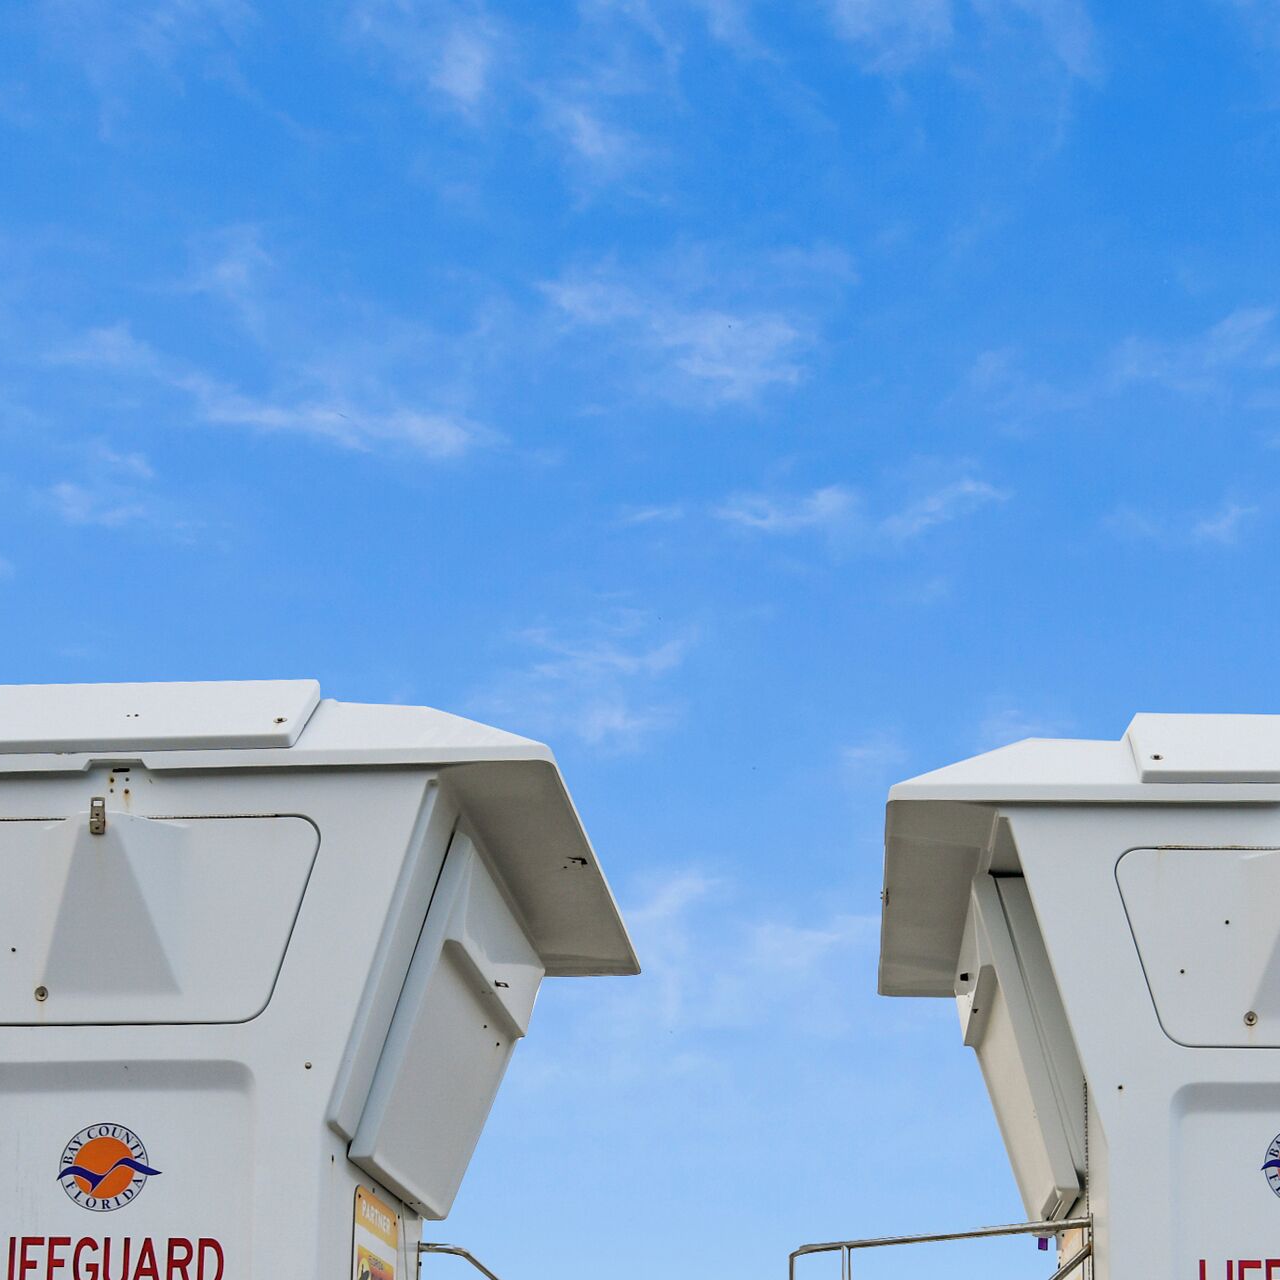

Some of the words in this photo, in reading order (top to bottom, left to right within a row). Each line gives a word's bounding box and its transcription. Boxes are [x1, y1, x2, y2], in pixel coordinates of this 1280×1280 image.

[62, 1136, 84, 1165] BAY
[87, 1125, 146, 1161] COUNTY
[65, 1176, 143, 1210] FLORIDA
[362, 1198, 391, 1233] PARTNER
